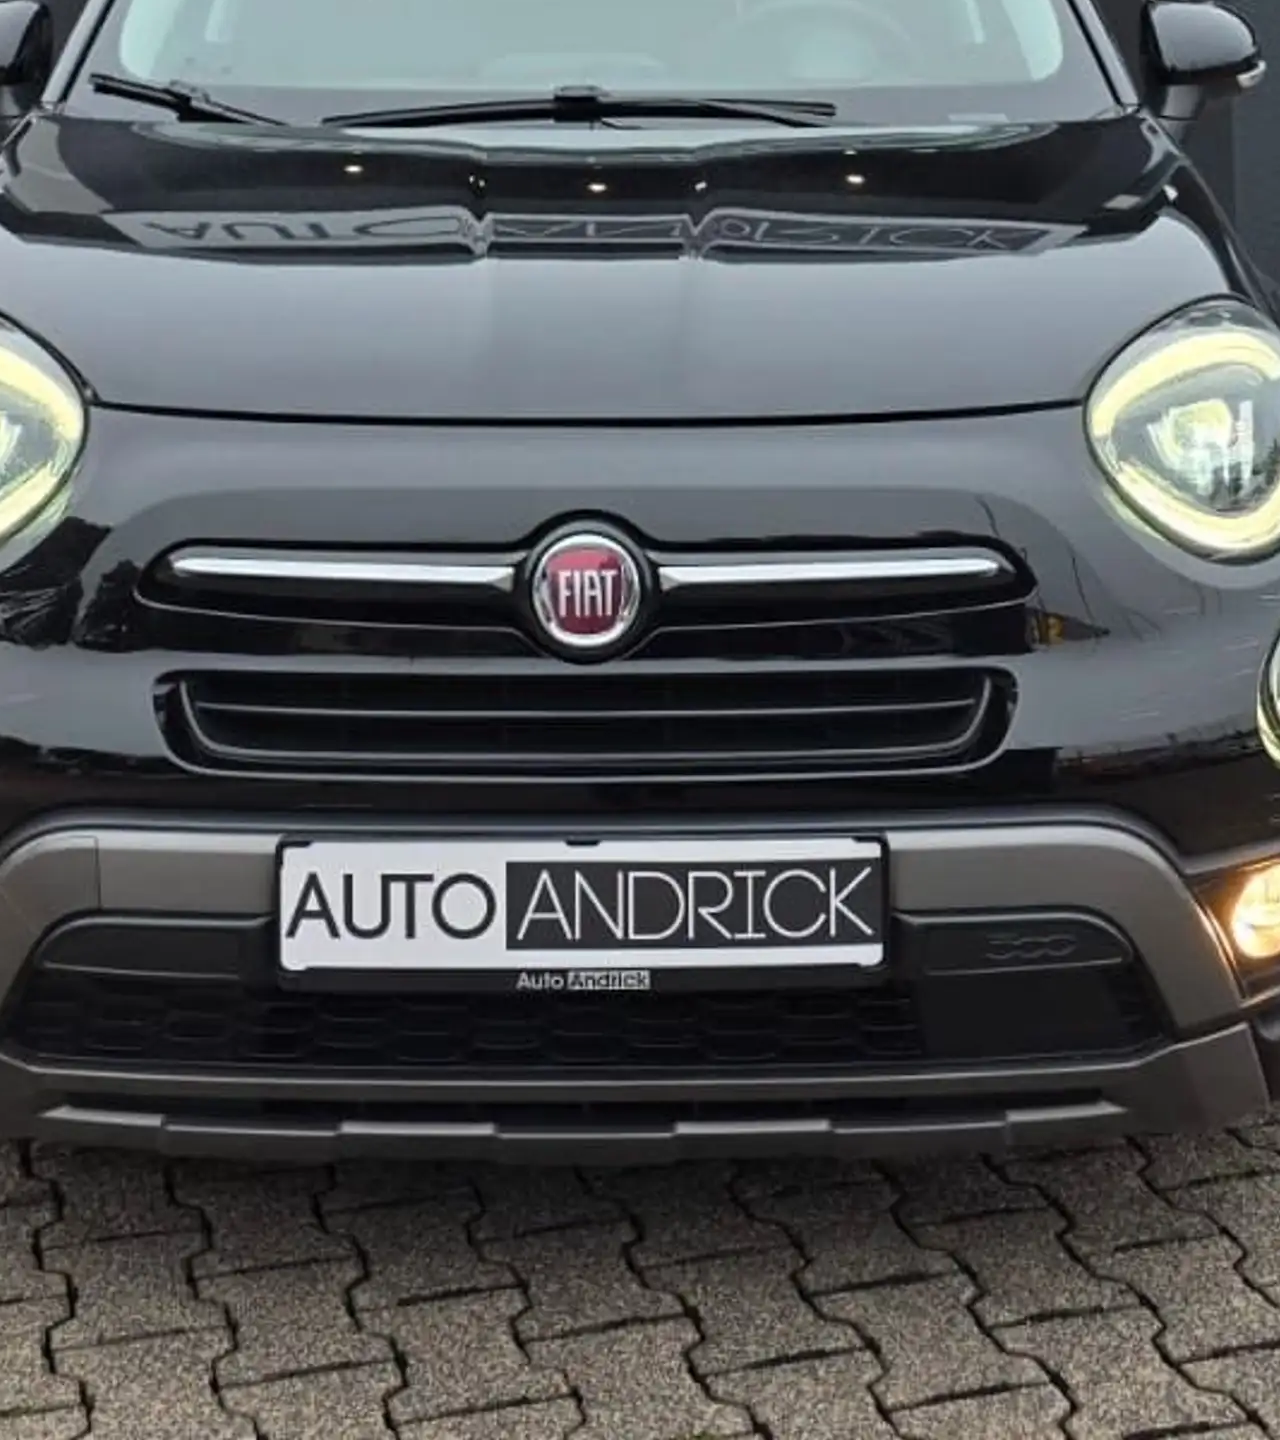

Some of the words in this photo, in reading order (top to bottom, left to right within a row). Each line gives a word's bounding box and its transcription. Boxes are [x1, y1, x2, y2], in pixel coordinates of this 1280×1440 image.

[558, 568, 619, 618] FIAT
[285, 871, 497, 940] AUTO
[517, 865, 876, 941] ANDRICK
[516, 970, 565, 990] Auto
[569, 970, 650, 989] Andrick
